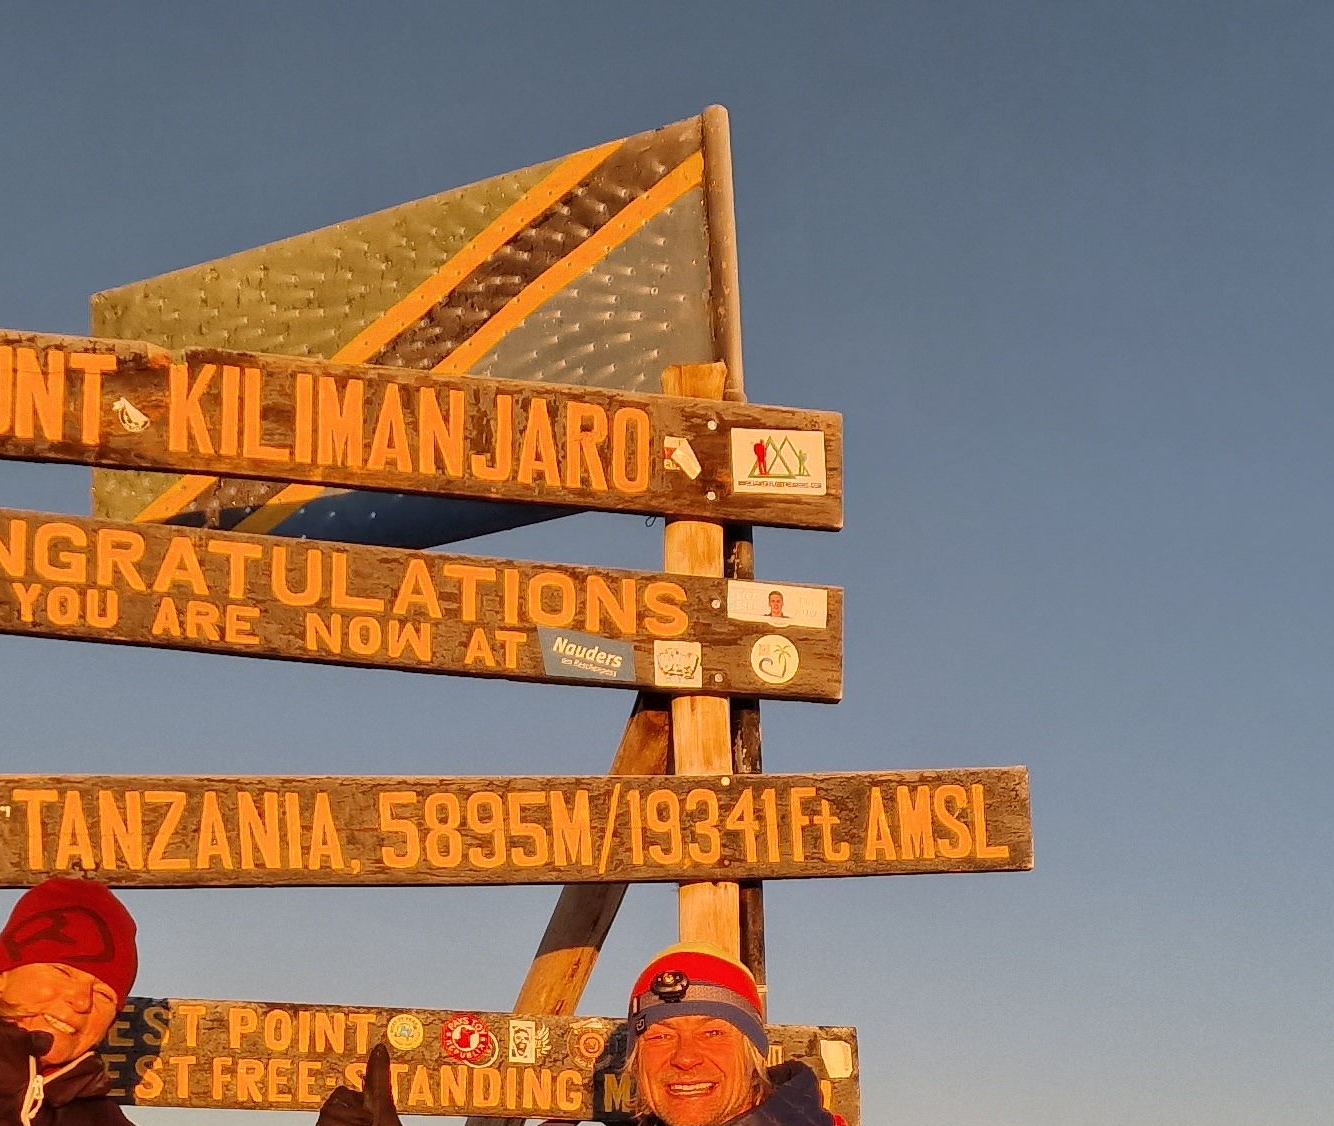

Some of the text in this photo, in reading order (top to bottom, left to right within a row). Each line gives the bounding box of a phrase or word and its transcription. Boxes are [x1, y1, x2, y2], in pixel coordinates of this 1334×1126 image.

[167, 363, 651, 493] KILIMANJARO
[12, 583, 119, 628] YOU
[152, 597, 260, 645] ARE
[305, 613, 432, 662] NOW
[465, 627, 528, 668] AT
[553, 636, 623, 668] Nauders
[12, 789, 361, 875] TANZANIA,
[865, 784, 1010, 861] AMSL
[107, 1004, 207, 1047] EST
[229, 1007, 378, 1053] POINT
[100, 1054, 197, 1099] EST
